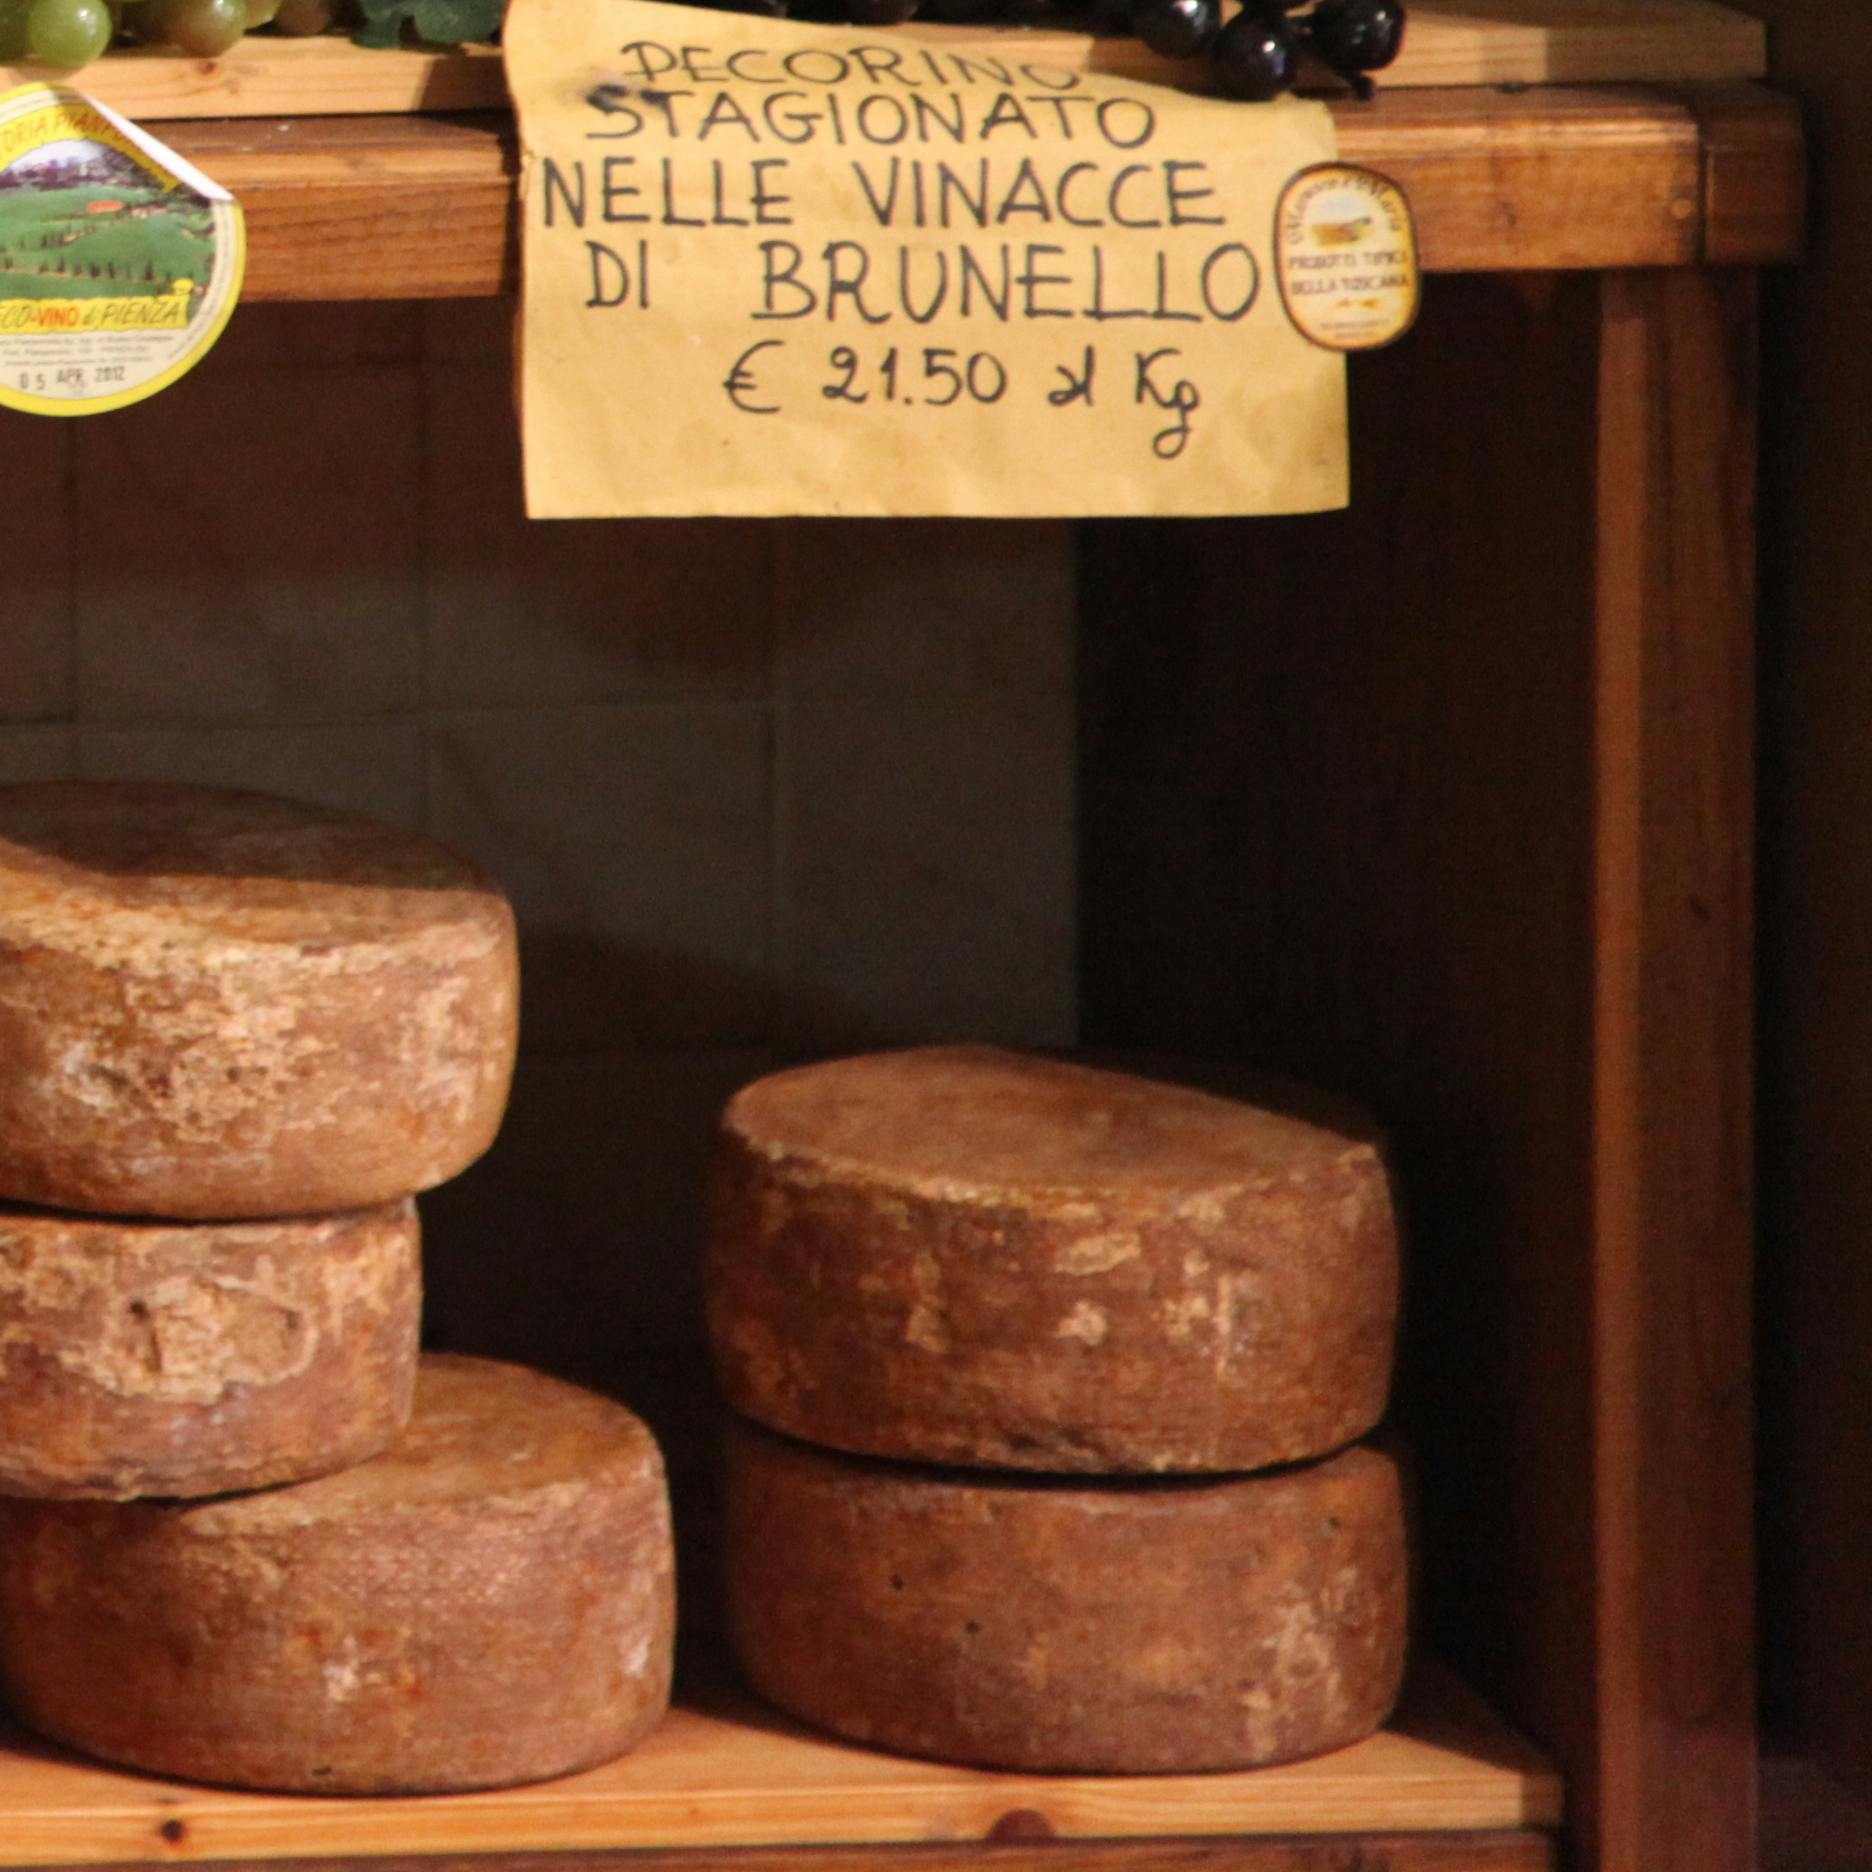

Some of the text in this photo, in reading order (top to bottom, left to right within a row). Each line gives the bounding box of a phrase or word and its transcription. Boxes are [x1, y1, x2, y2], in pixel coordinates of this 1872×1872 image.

[582, 83, 1157, 149] STAGIONATO
[543, 155, 1226, 229] NELLE VINACCE
[96, 302, 182, 327] PIENZA
[584, 240, 1262, 326] DI BRUNELLO
[722, 339, 786, 413] €
[821, 343, 1009, 408] 21.50
